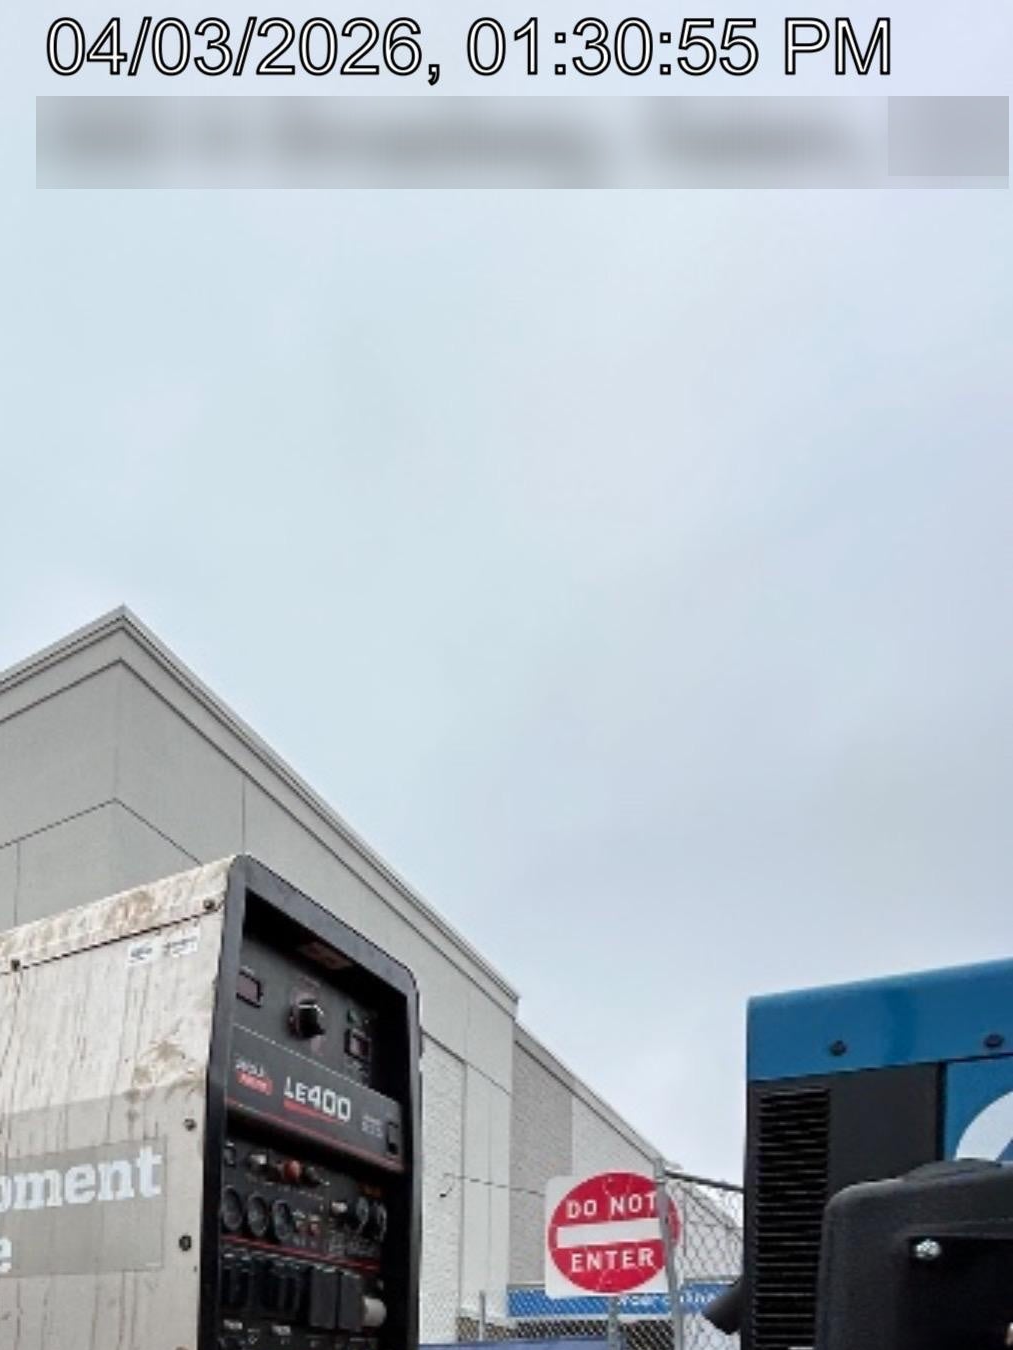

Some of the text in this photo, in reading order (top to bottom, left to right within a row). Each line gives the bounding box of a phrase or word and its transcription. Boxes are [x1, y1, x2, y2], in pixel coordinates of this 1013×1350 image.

[283, 1076, 351, 1122] LE400
[567, 1190, 657, 1219] DO NOT
[571, 1247, 656, 1273] ENTER
